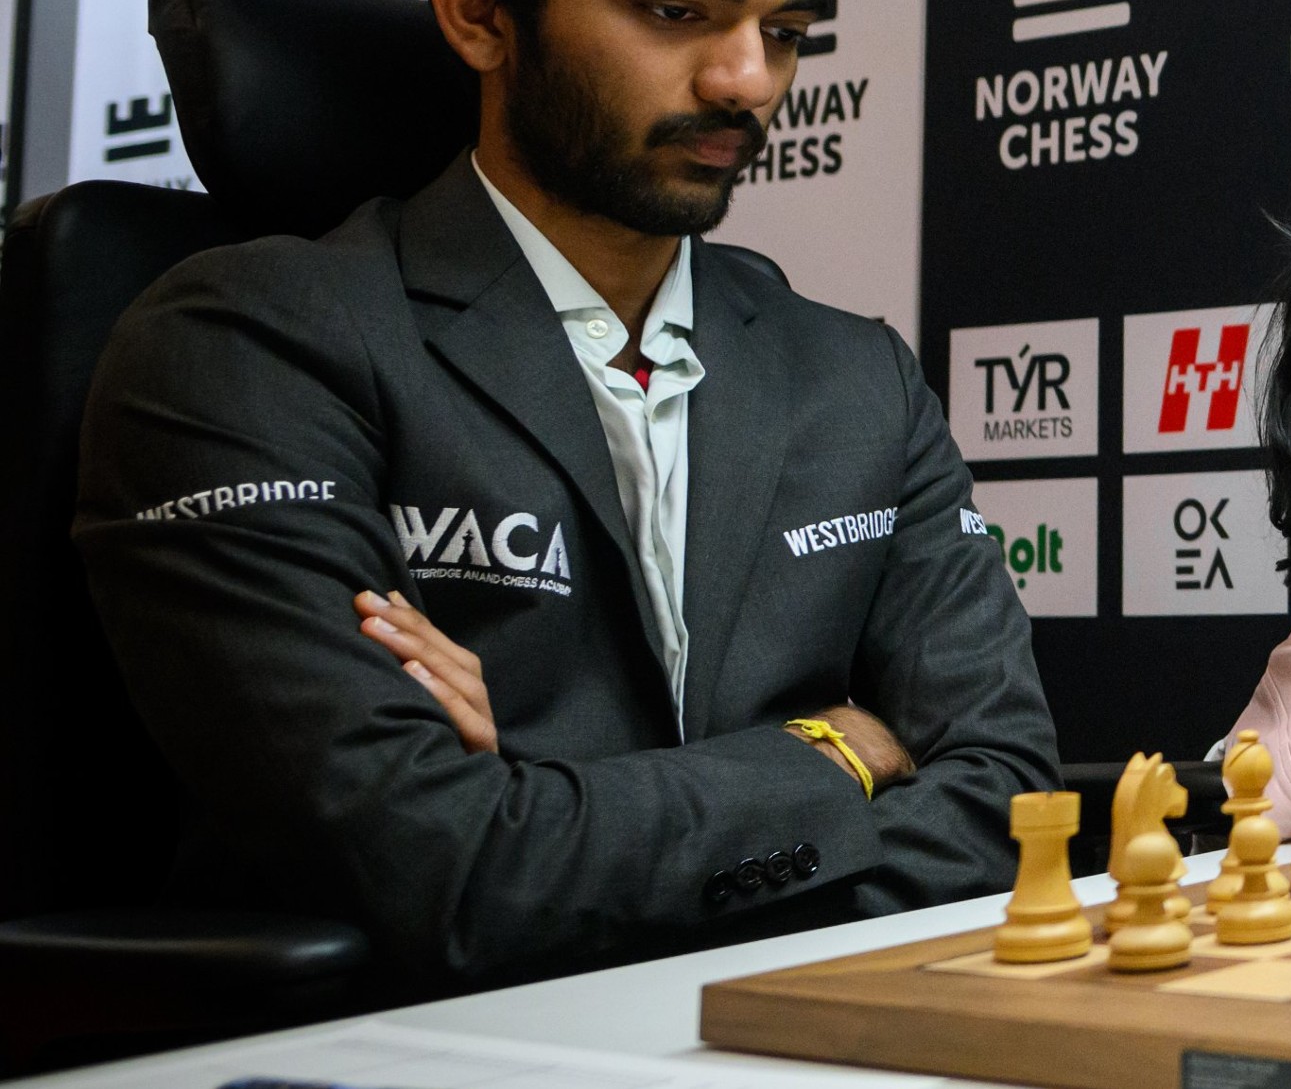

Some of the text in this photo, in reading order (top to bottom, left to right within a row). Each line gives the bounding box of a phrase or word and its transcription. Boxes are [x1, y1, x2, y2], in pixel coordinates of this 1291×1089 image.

[976, 51, 1167, 120] NORWAY
[734, 133, 842, 186] HESS
[1000, 110, 1138, 169] CHESS
[984, 417, 1072, 441] MARKETS
[389, 504, 571, 580] WACA
